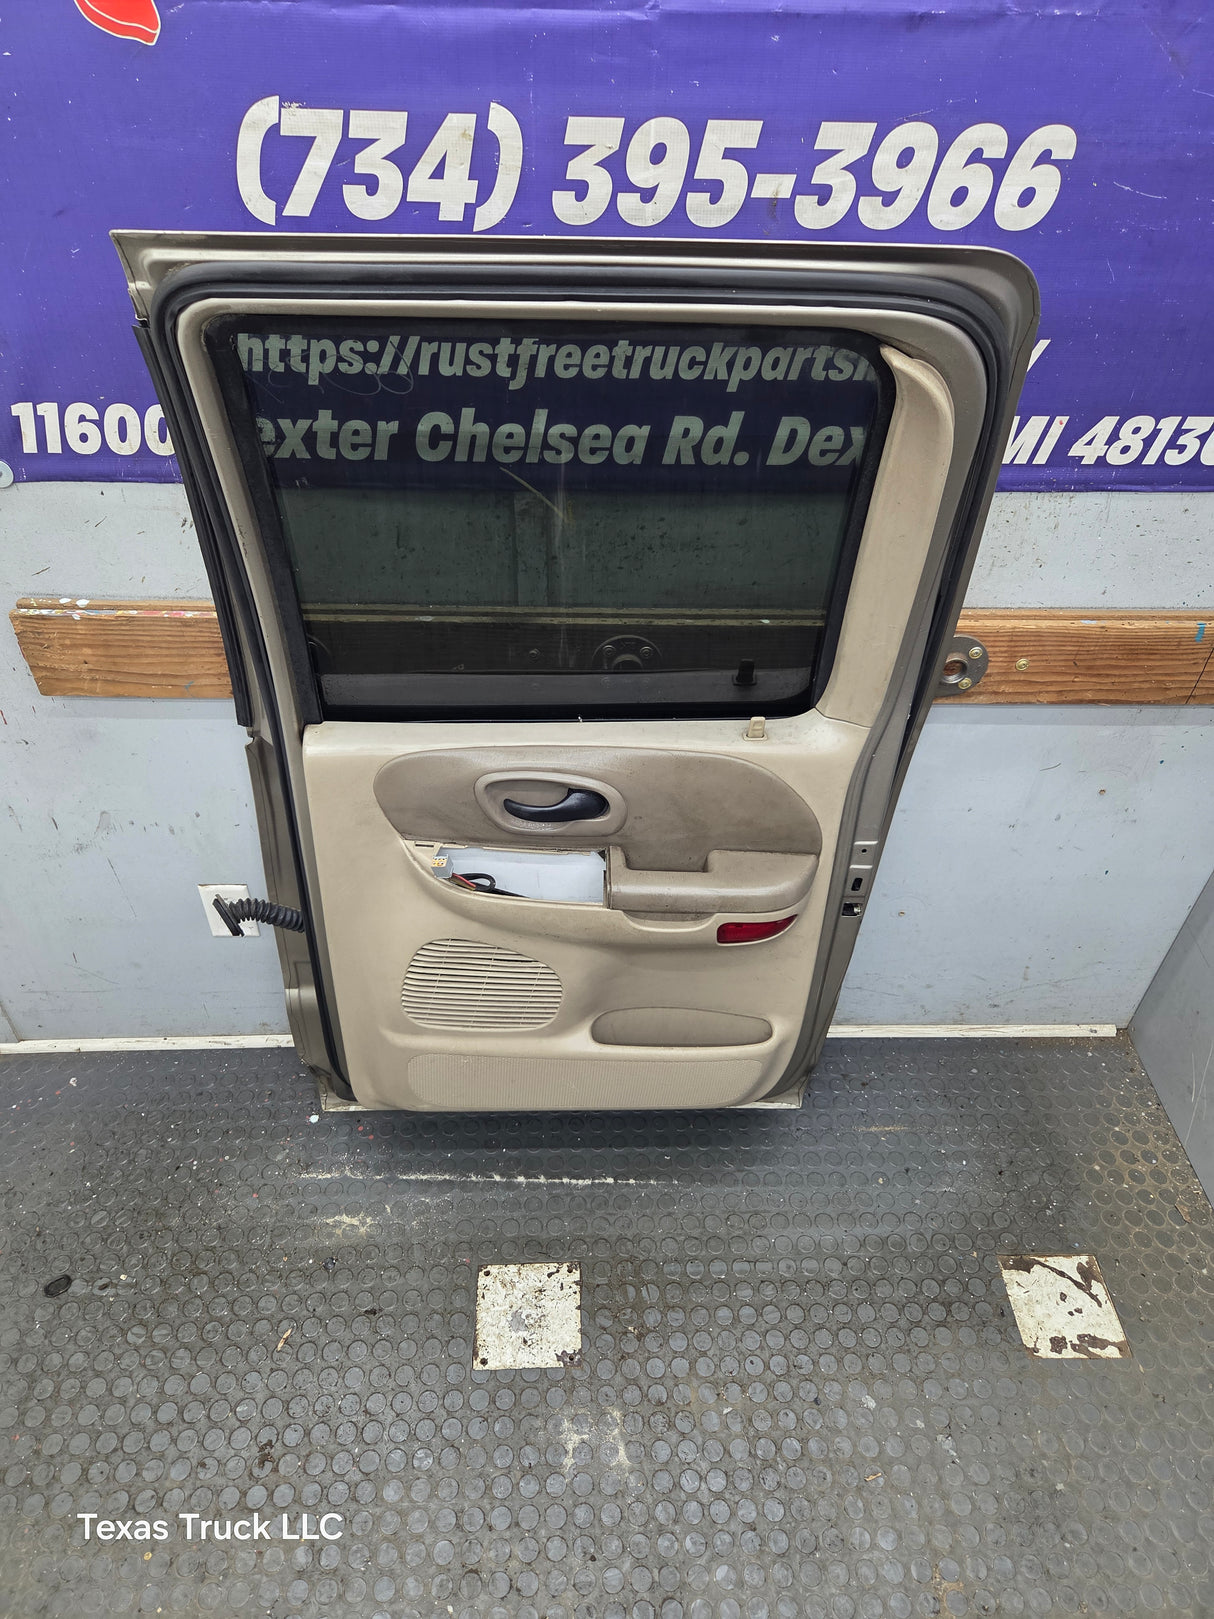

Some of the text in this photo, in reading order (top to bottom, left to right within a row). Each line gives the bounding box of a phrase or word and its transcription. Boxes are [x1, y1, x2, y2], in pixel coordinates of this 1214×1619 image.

[236, 95, 1077, 232] (734) 395-3966
[11, 402, 176, 456] 11600
[415, 407, 650, 464] Chelsea
[661, 411, 750, 466] Rd.
